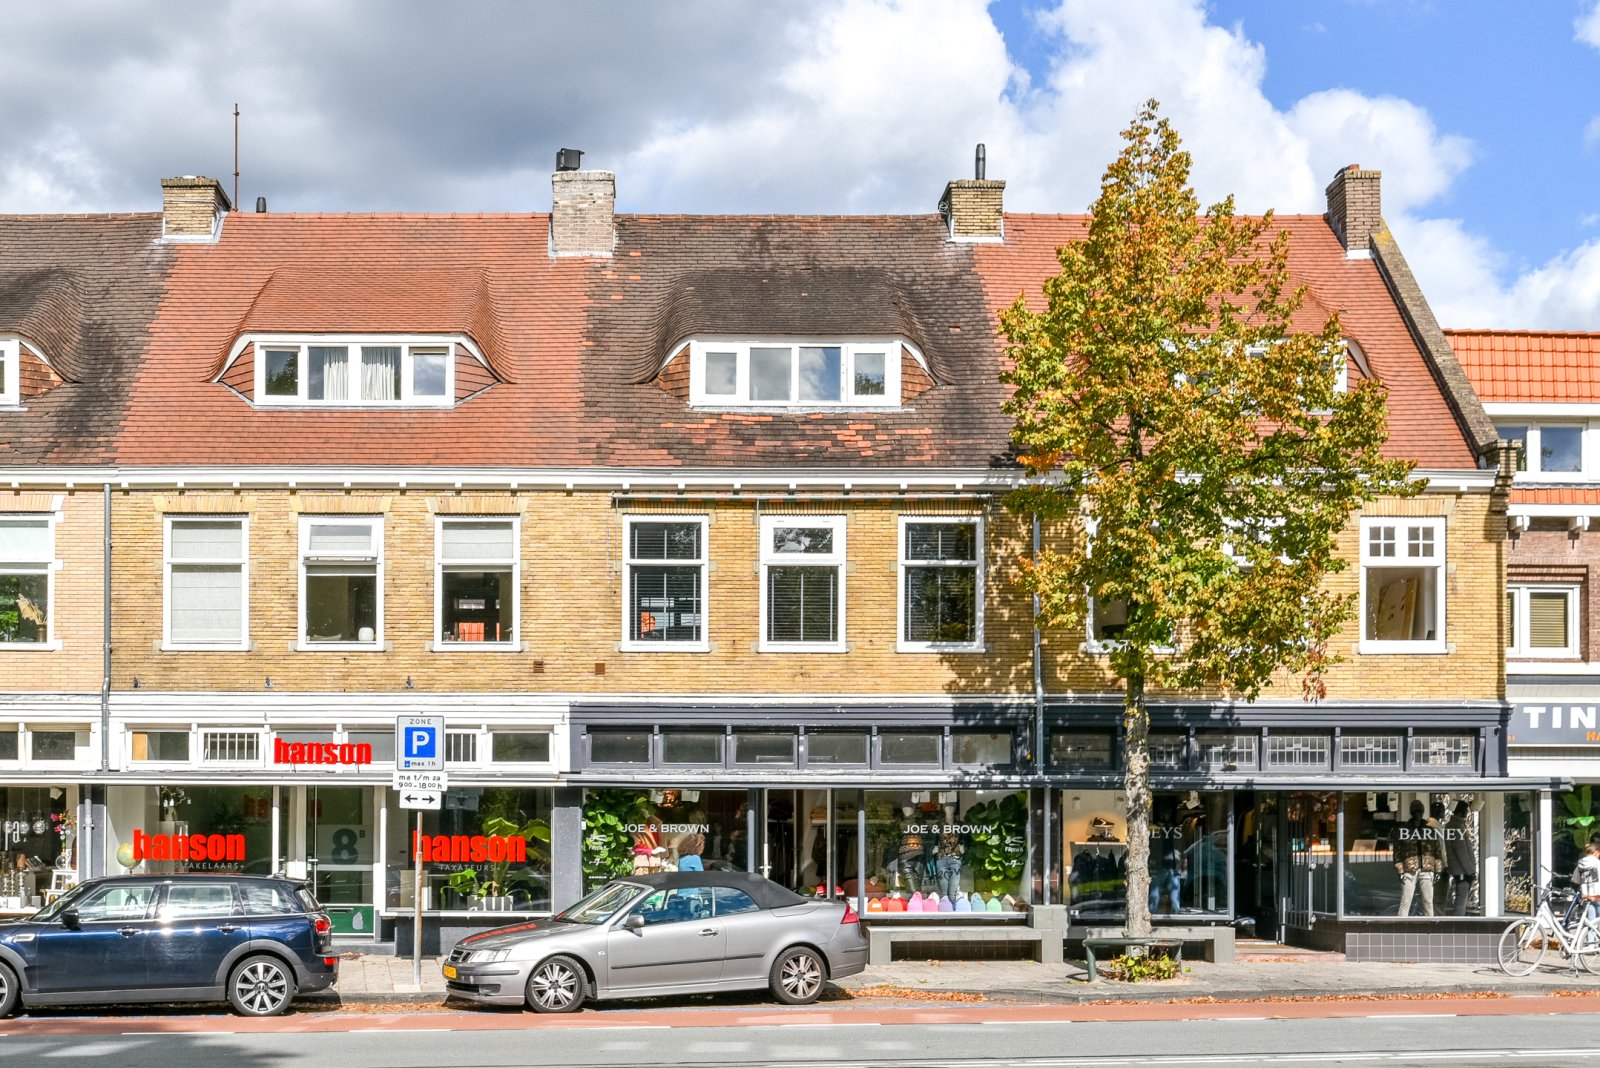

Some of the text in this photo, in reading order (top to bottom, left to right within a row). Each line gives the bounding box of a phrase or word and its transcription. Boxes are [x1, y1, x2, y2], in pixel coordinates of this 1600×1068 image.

[274, 737, 372, 765] hanson
[412, 730, 430, 755] P
[621, 823, 710, 833] JOE & BROWN
[903, 824, 992, 834] JOE & BROWN
[1398, 827, 1475, 841] BARNEY
[133, 829, 246, 861] hanson
[331, 827, 358, 866] 8
[413, 830, 526, 863] hanson
